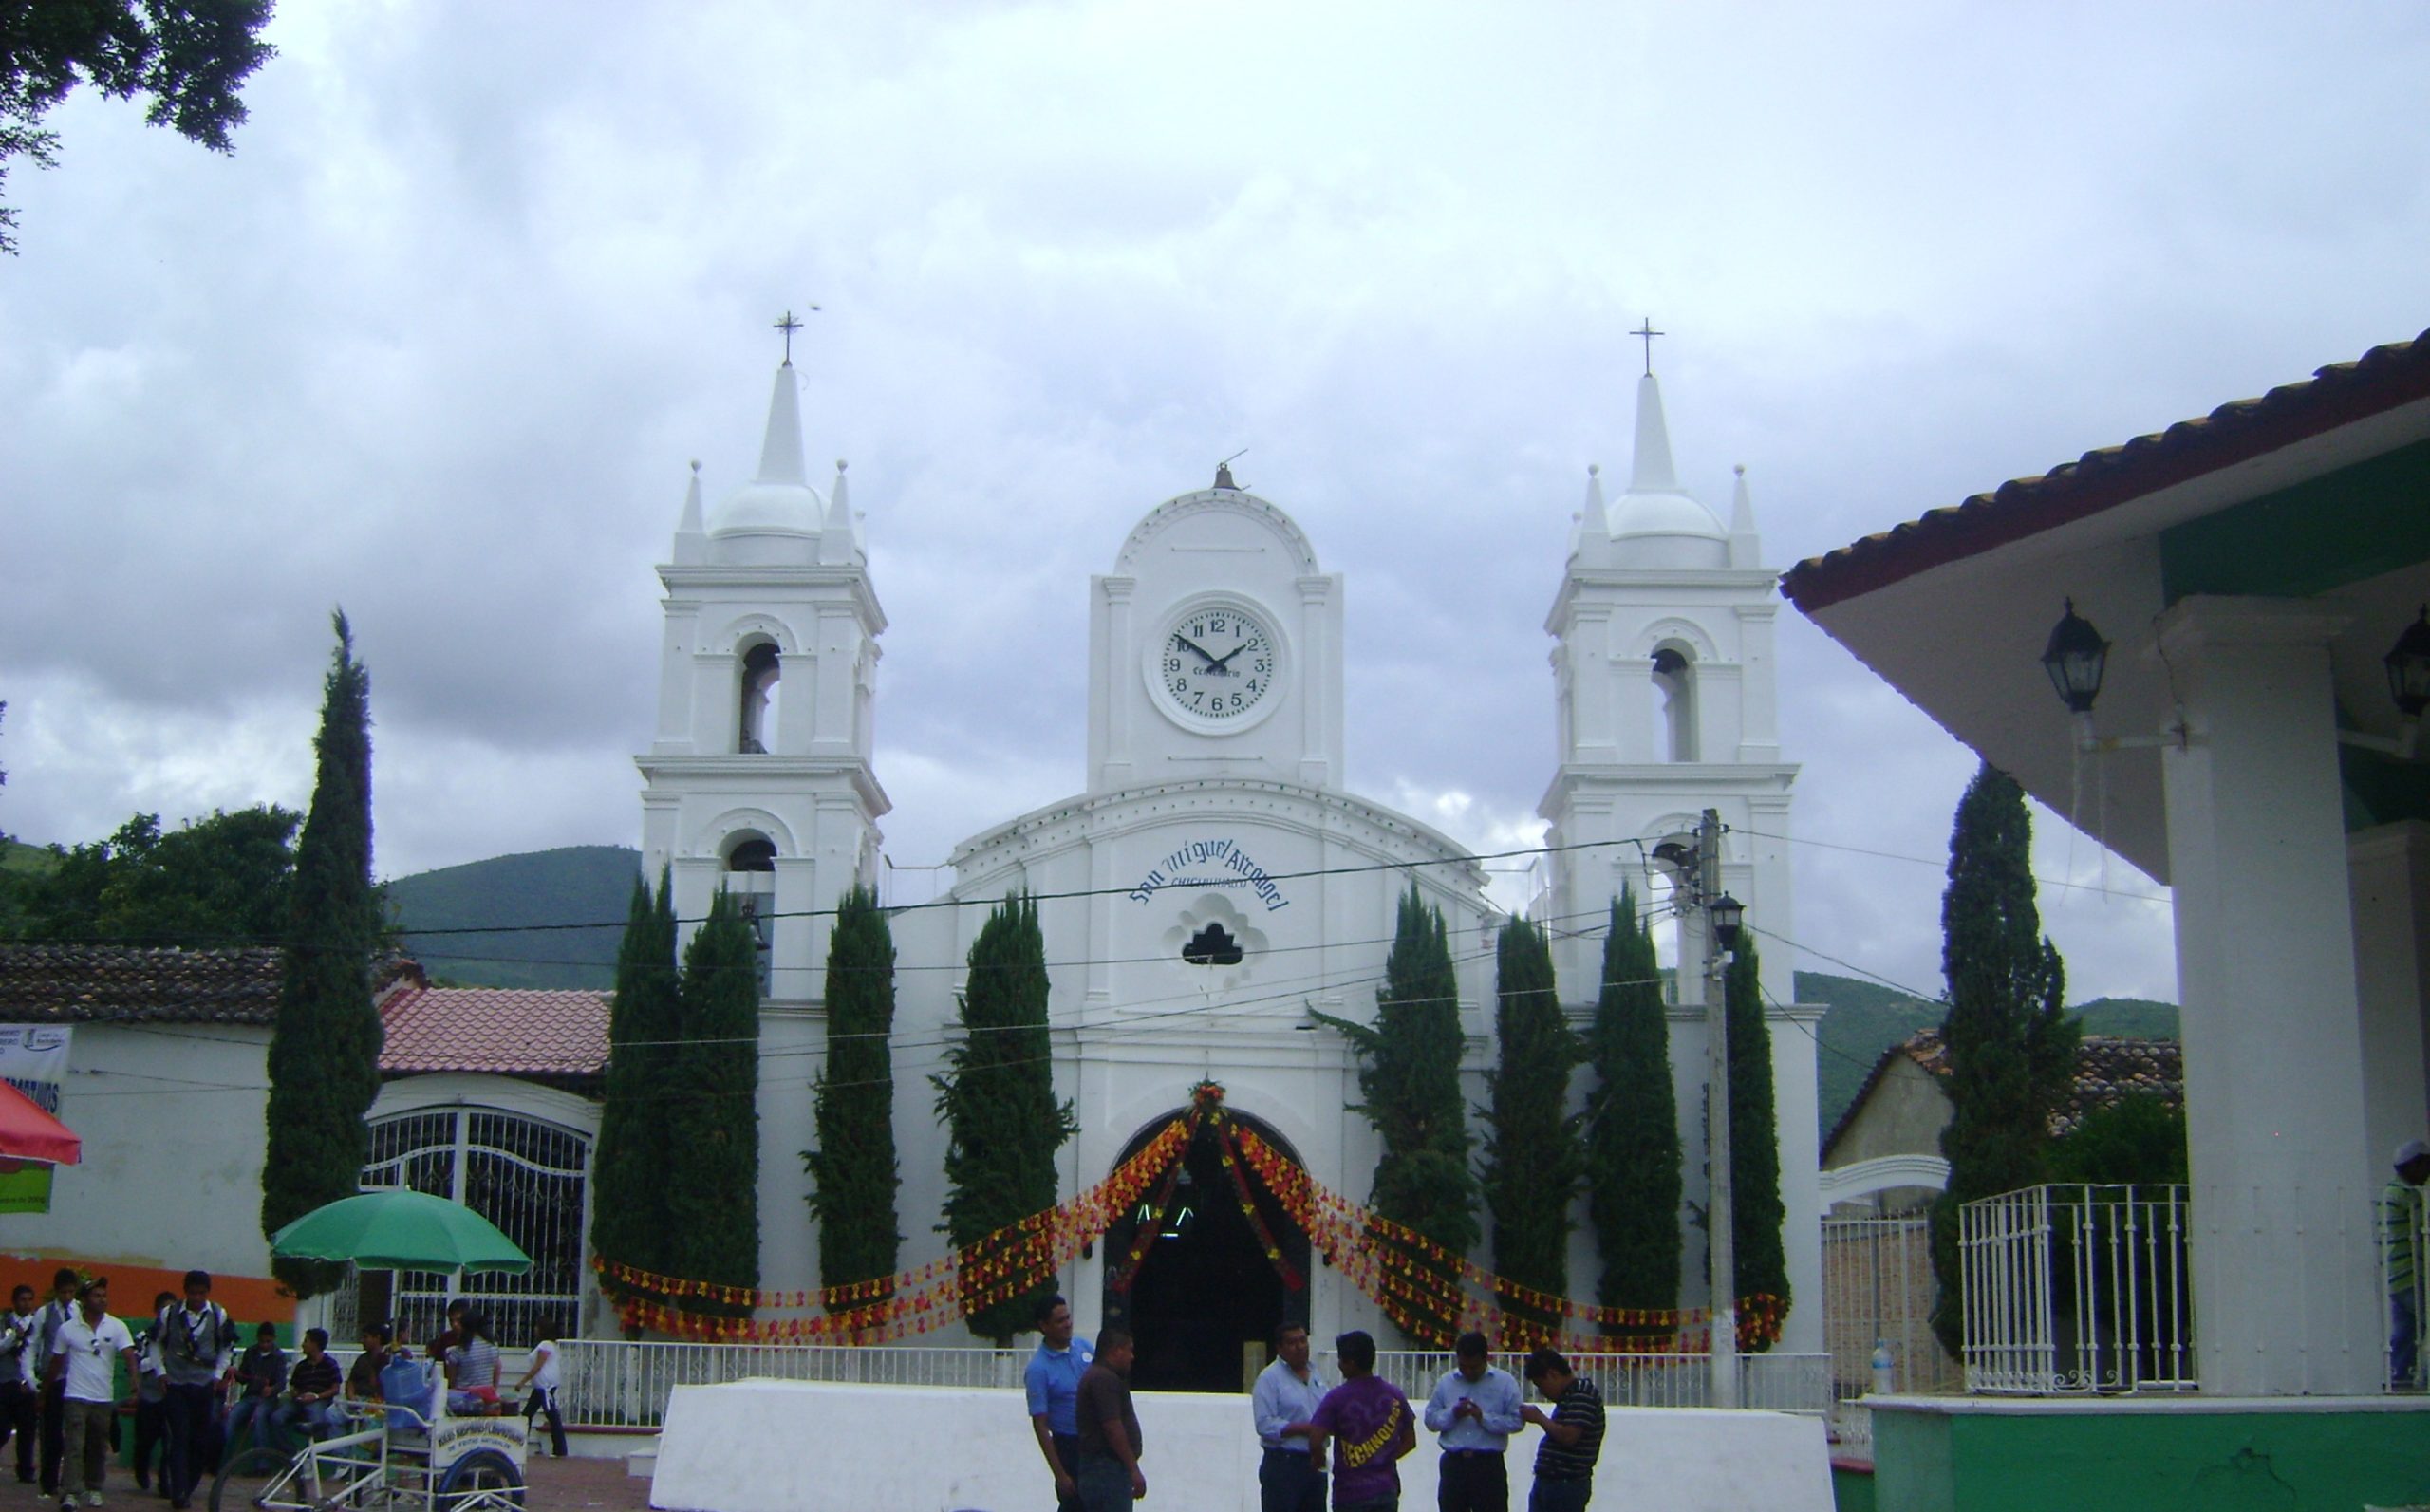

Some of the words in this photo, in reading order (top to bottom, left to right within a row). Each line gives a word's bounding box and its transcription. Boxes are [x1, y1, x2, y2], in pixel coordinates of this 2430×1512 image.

[1193, 625, 1204, 637] 11
[1210, 619, 1225, 633] 12
[1235, 625, 1240, 637] 1
[1176, 641, 1189, 652] 10
[1247, 638, 1259, 651] 2
[1169, 659, 1181, 672] 9
[1254, 659, 1265, 672] 3
[1177, 678, 1187, 692] 8
[1246, 679, 1257, 692] 4
[1193, 692, 1204, 705] 7
[1211, 698, 1223, 711] 6
[1230, 693, 1242, 706] 5
[1340, 1398, 1401, 1467] TECHNOLOGY
